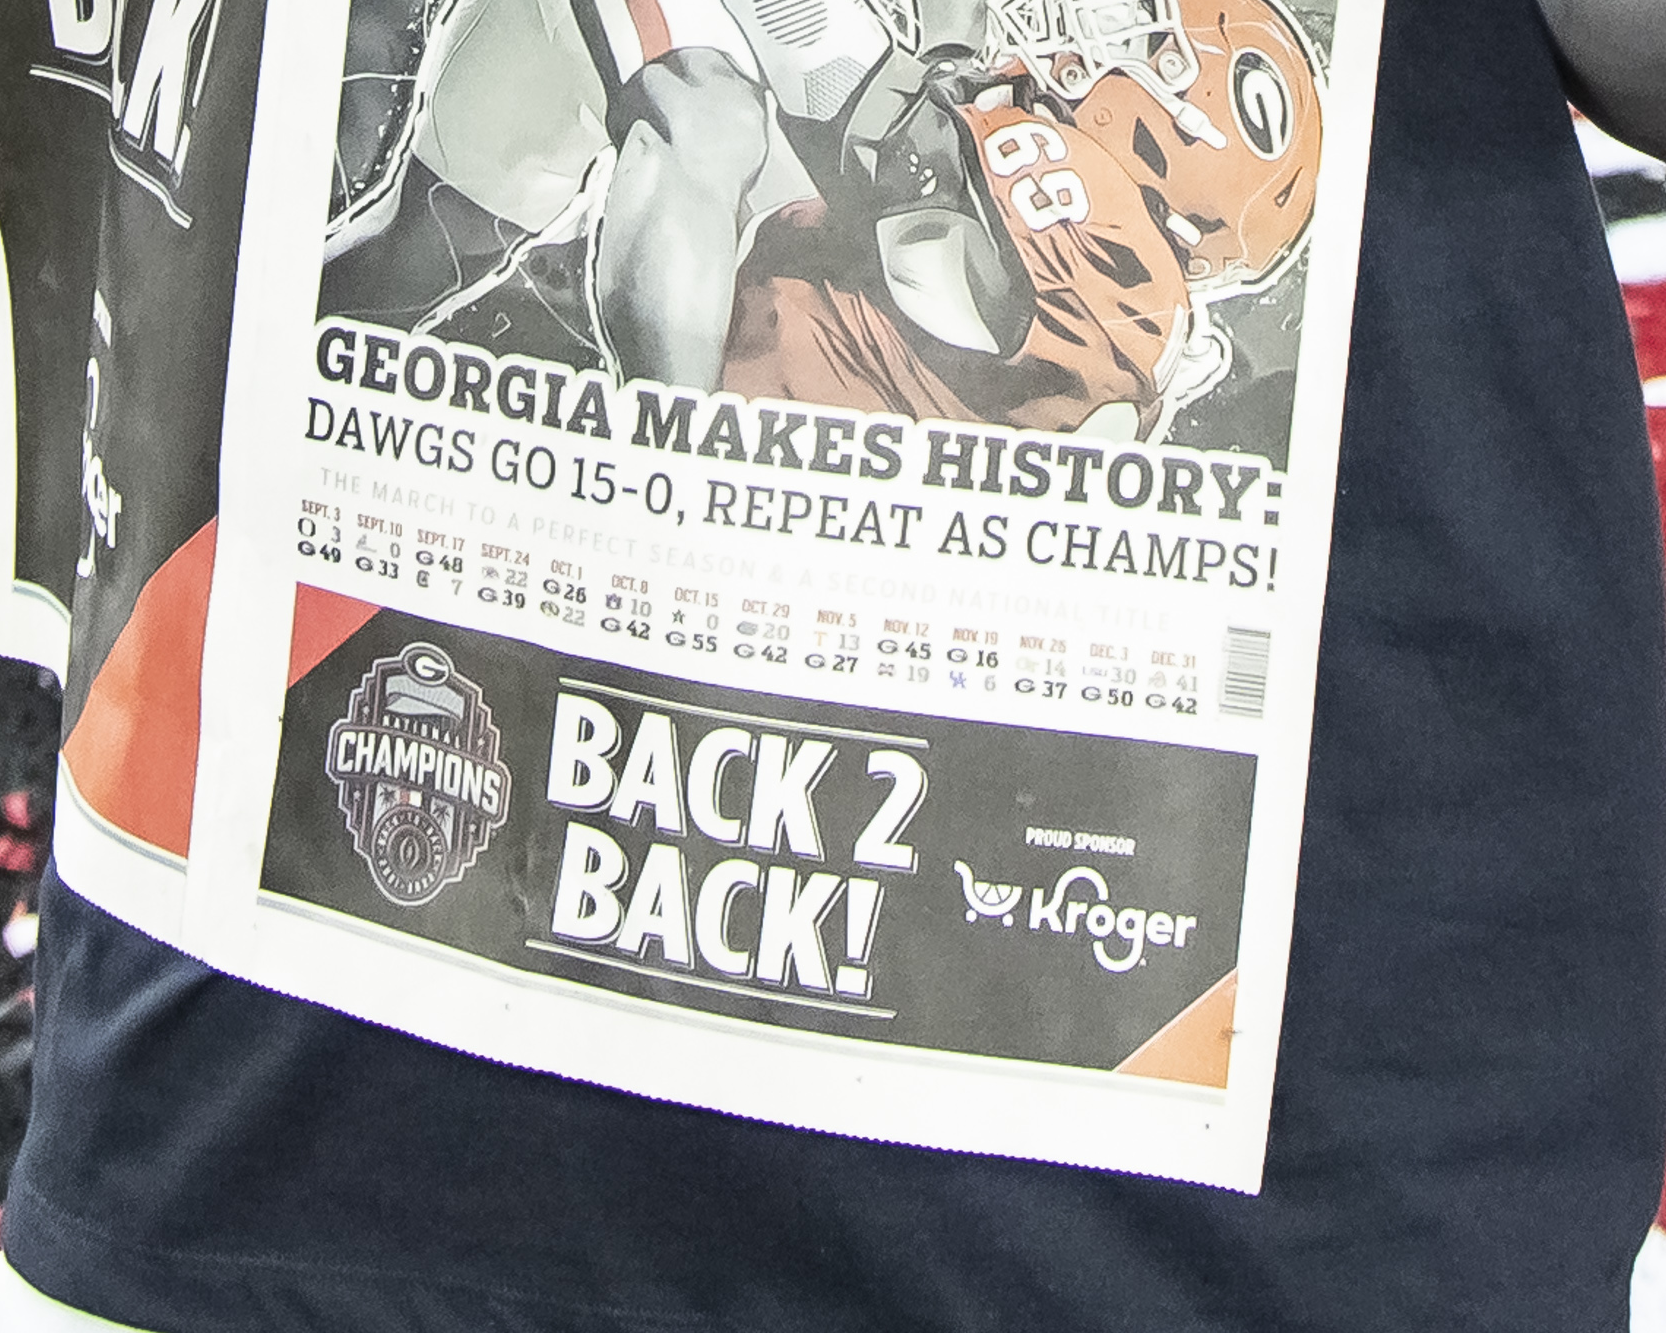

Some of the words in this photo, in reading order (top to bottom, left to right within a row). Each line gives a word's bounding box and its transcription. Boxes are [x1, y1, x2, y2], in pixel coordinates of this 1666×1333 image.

[315, 326, 613, 440] GEORGIA
[631, 390, 904, 480] MAKES
[922, 430, 1282, 526] HISTORY:
[305, 397, 476, 473] DAWGS
[491, 439, 557, 489] GO
[571, 457, 687, 527] 15-0,
[703, 479, 923, 549] REPEAT
[938, 510, 1009, 560] AS
[1026, 521, 1278, 592] CHAMPS!
[302, 500, 330, 519] SEPT.
[333, 507, 341, 522] 3
[331, 526, 341, 543] 3
[357, 514, 387, 534] SEPT.
[389, 523, 403, 537] 10
[320, 467, 361, 495] THE
[372, 481, 453, 517] MARCH
[469, 504, 495, 525] TO
[507, 512, 521, 531] A
[533, 517, 636, 558] PERFECT
[649, 541, 756, 579] SEASON
[827, 571, 936, 604] SECOND
[949, 586, 1085, 624] NATIONAL
[1098, 603, 1171, 632] TITLE
[417, 529, 449, 548] SEPT.
[452, 537, 465, 552] 17
[482, 543, 513, 561] SEPT.
[515, 551, 530, 566] 24
[378, 560, 399, 579] 33
[505, 568, 528, 588] 22
[551, 559, 575, 578] OCT.
[578, 566, 583, 581] 1
[611, 574, 637, 593] OCT.
[502, 589, 525, 609] 39
[674, 587, 700, 605] OCT.
[705, 593, 718, 607] 15
[562, 606, 585, 627] 22
[631, 599, 652, 617] 10
[742, 598, 768, 616] OCT.
[817, 609, 844, 627] NOV.
[849, 613, 856, 628] 5
[883, 618, 911, 635] NOV.
[915, 622, 929, 637] 12
[626, 620, 650, 640] 42
[952, 627, 980, 643] NOV.
[692, 634, 717, 653] 55
[905, 641, 931, 660] 45
[1020, 635, 1046, 651] NOV.
[1090, 643, 1116, 660] DEC.
[1120, 646, 1129, 661] 3
[761, 645, 787, 664] 42
[832, 654, 858, 673] 27
[1151, 651, 1178, 667] DEC.
[1182, 653, 1196, 668] 31
[1042, 681, 1067, 699] 37
[1108, 688, 1133, 706] 50
[1171, 696, 1197, 715] 42
[335, 729, 502, 815] CHAMPIONS
[546, 692, 839, 862] BACK
[852, 748, 929, 874] 2
[1025, 827, 1073, 850] PROUD
[1073, 831, 1137, 857] SPONSOR
[550, 820, 885, 999] BACK!
[1028, 865, 1198, 973] Kroger
